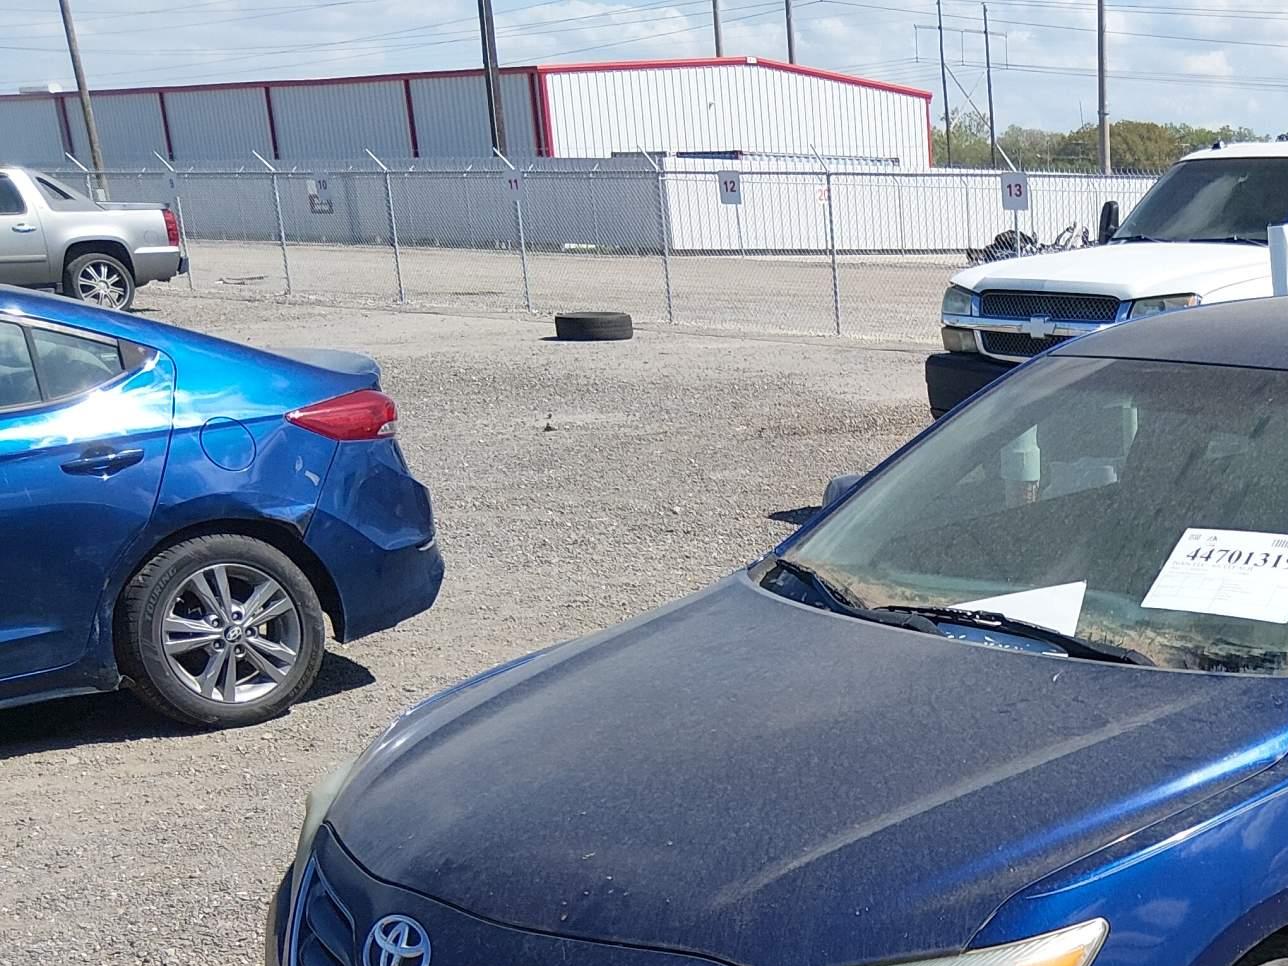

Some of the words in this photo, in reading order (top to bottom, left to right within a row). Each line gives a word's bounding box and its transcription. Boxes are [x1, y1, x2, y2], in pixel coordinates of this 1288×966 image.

[317, 179, 328, 190] 10
[507, 179, 519, 191] 11
[723, 179, 737, 193] 12
[1006, 183, 1023, 198] 13
[144, 566, 177, 621] TOURING
